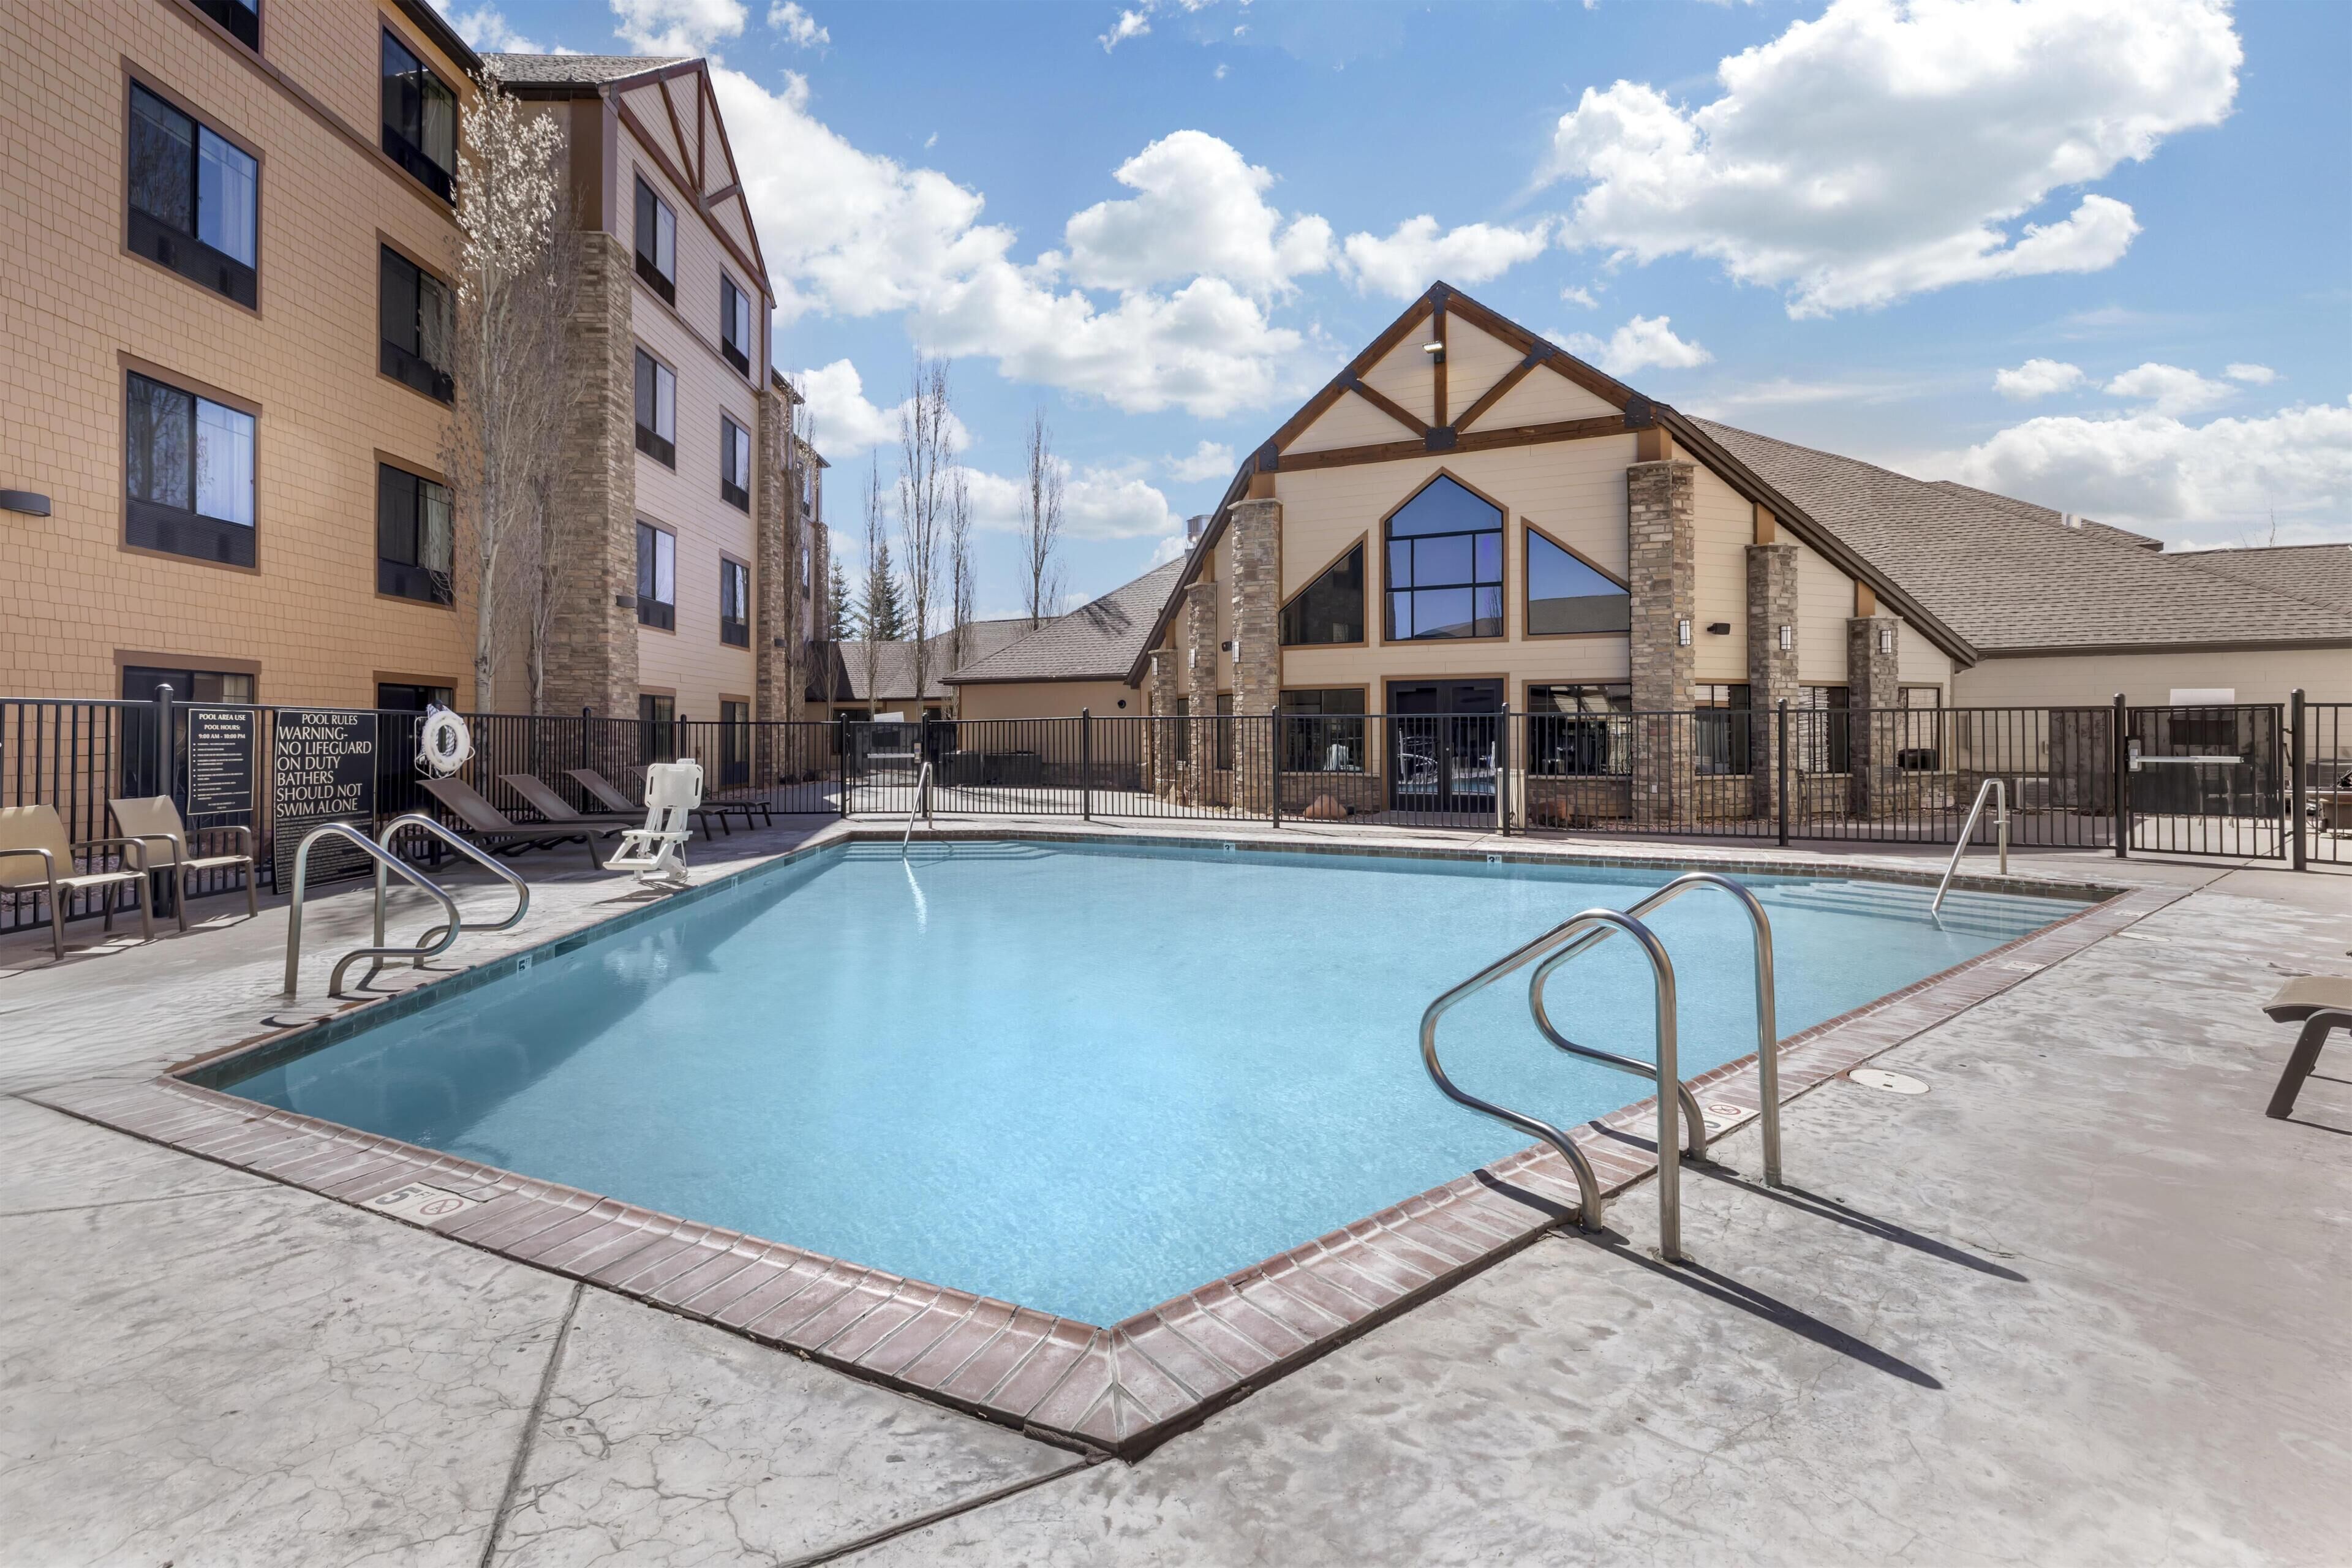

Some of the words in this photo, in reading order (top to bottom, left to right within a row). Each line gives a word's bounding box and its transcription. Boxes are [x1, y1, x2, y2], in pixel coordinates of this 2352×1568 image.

[302, 714, 329, 724] POOL
[332, 715, 358, 725] RULES
[279, 726, 348, 740] WARNING-
[278, 742, 301, 755] NO
[306, 741, 371, 755] LIFEGUARD
[277, 756, 300, 771] ON
[306, 756, 341, 770] DUTY
[277, 771, 333, 786] BATHERS
[277, 785, 333, 802] SHOULD
[337, 783, 363, 797] NOT
[277, 802, 314, 817] SWIM
[317, 798, 358, 813] ALONE
[519, 959, 525, 971] 5
[375, 1186, 423, 1205] 5
